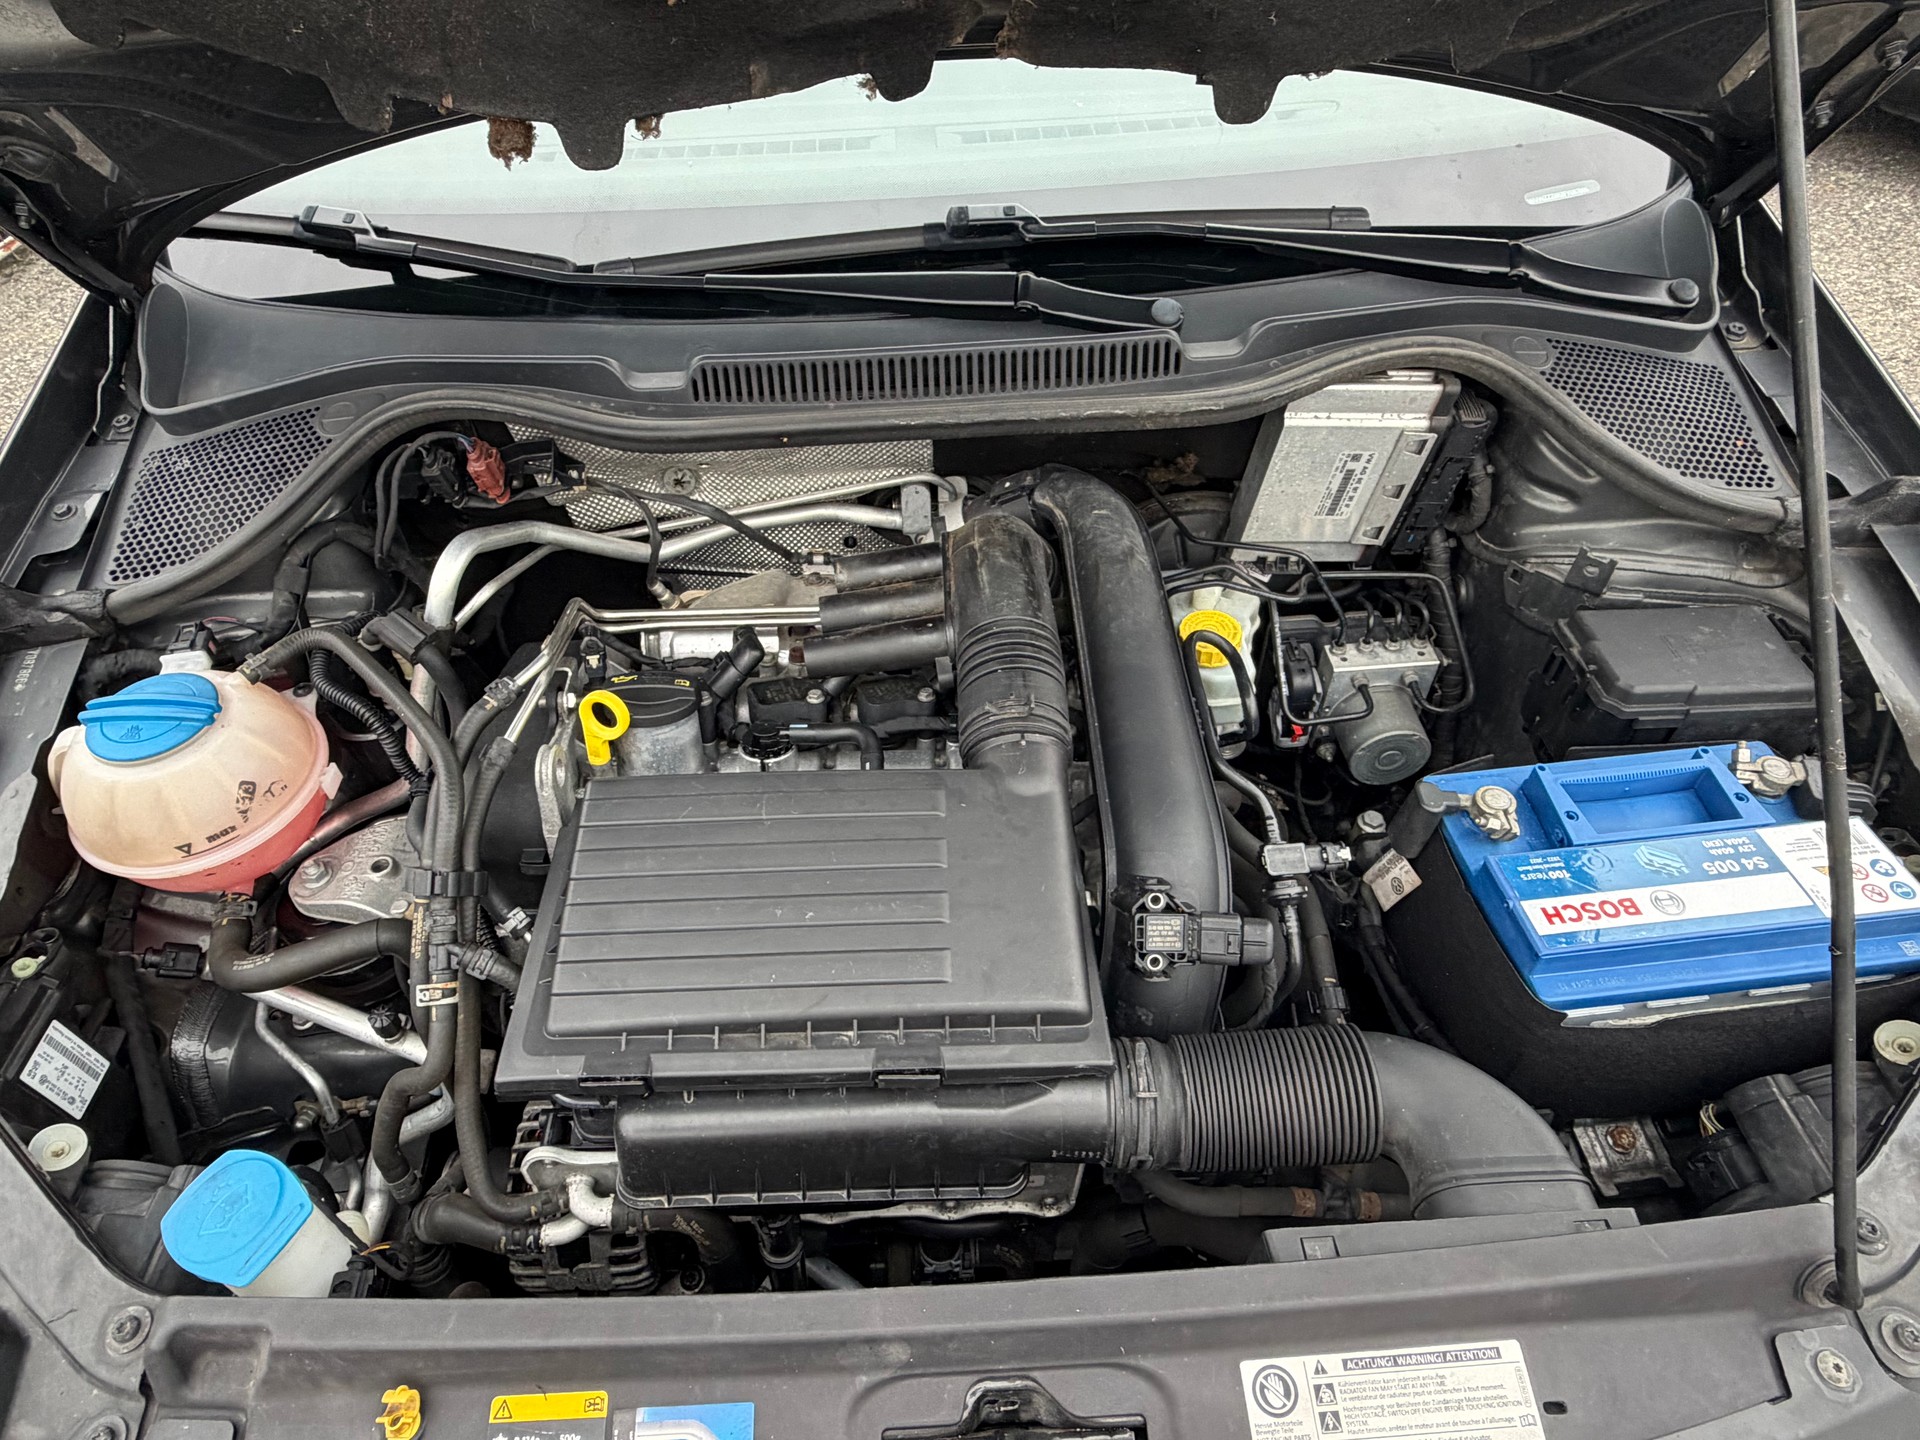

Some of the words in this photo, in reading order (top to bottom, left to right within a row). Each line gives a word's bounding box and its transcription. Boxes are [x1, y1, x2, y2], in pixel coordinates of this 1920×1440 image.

[1702, 838, 1724, 848] (EN)
[1708, 847, 1735, 856] 60Ah
[1737, 844, 1757, 853] 12V
[1702, 859, 1741, 875] 005
[1740, 856, 1769, 870] S4
[1520, 871, 1550, 881] Years
[1549, 869, 1571, 880] 100
[1540, 897, 1643, 925] BOSCH
[1347, 1356, 1394, 1369] ACHTUNG!
[1396, 1353, 1444, 1365] WARNING!
[1446, 1349, 1498, 1362] ATTENTION!
[1444, 1404, 1465, 1413] BEFORE
